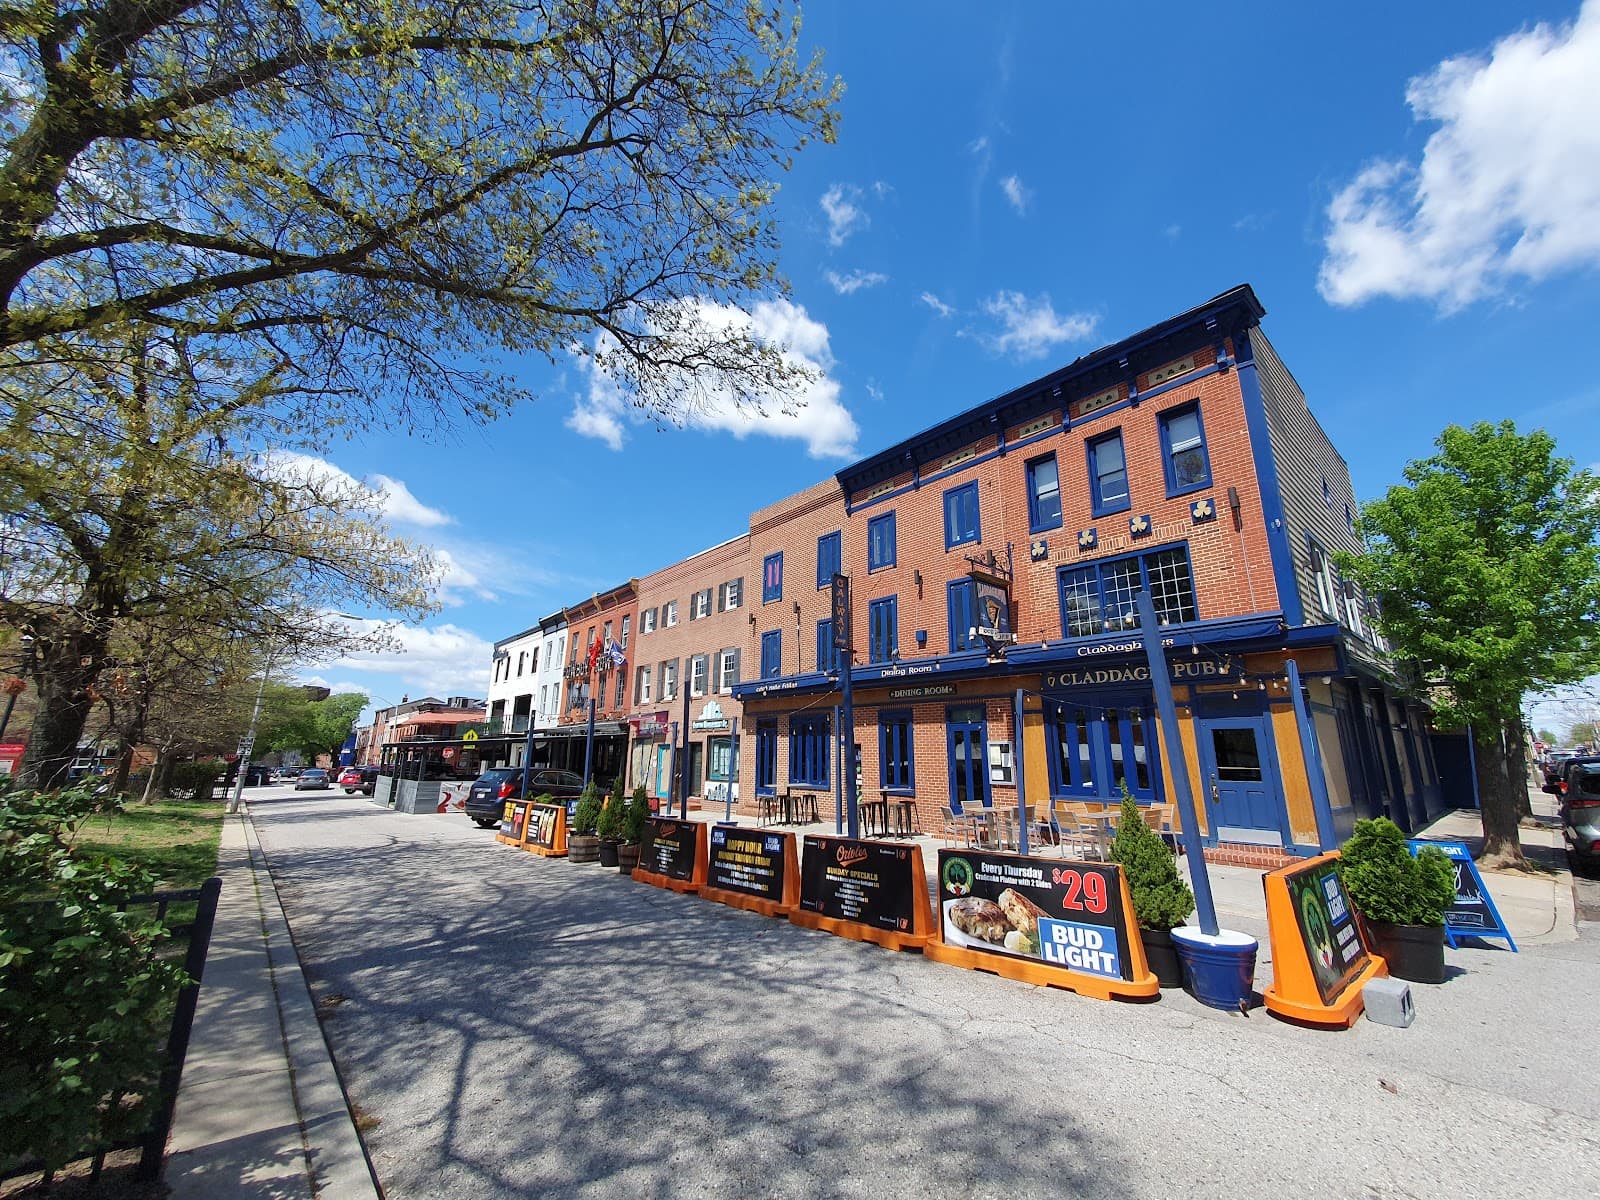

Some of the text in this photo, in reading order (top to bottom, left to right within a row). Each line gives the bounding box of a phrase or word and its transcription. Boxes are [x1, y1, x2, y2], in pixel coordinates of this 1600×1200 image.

[1077, 640, 1142, 656] Claddagh
[881, 666, 932, 677] Dining Room
[1172, 661, 1217, 678] PUB
[894, 686, 949, 698] DINING ROOM
[745, 841, 762, 855] HOUR
[836, 845, 868, 861] Orioles
[850, 870, 879, 881] SPECIALS
[981, 862, 1003, 875] Every
[1003, 865, 1043, 880] Thursday
[1018, 878, 1031, 887] with
[1052, 867, 1108, 914] $29
[1051, 924, 1103, 950] BUD
[1044, 942, 1116, 974] LIGHT
